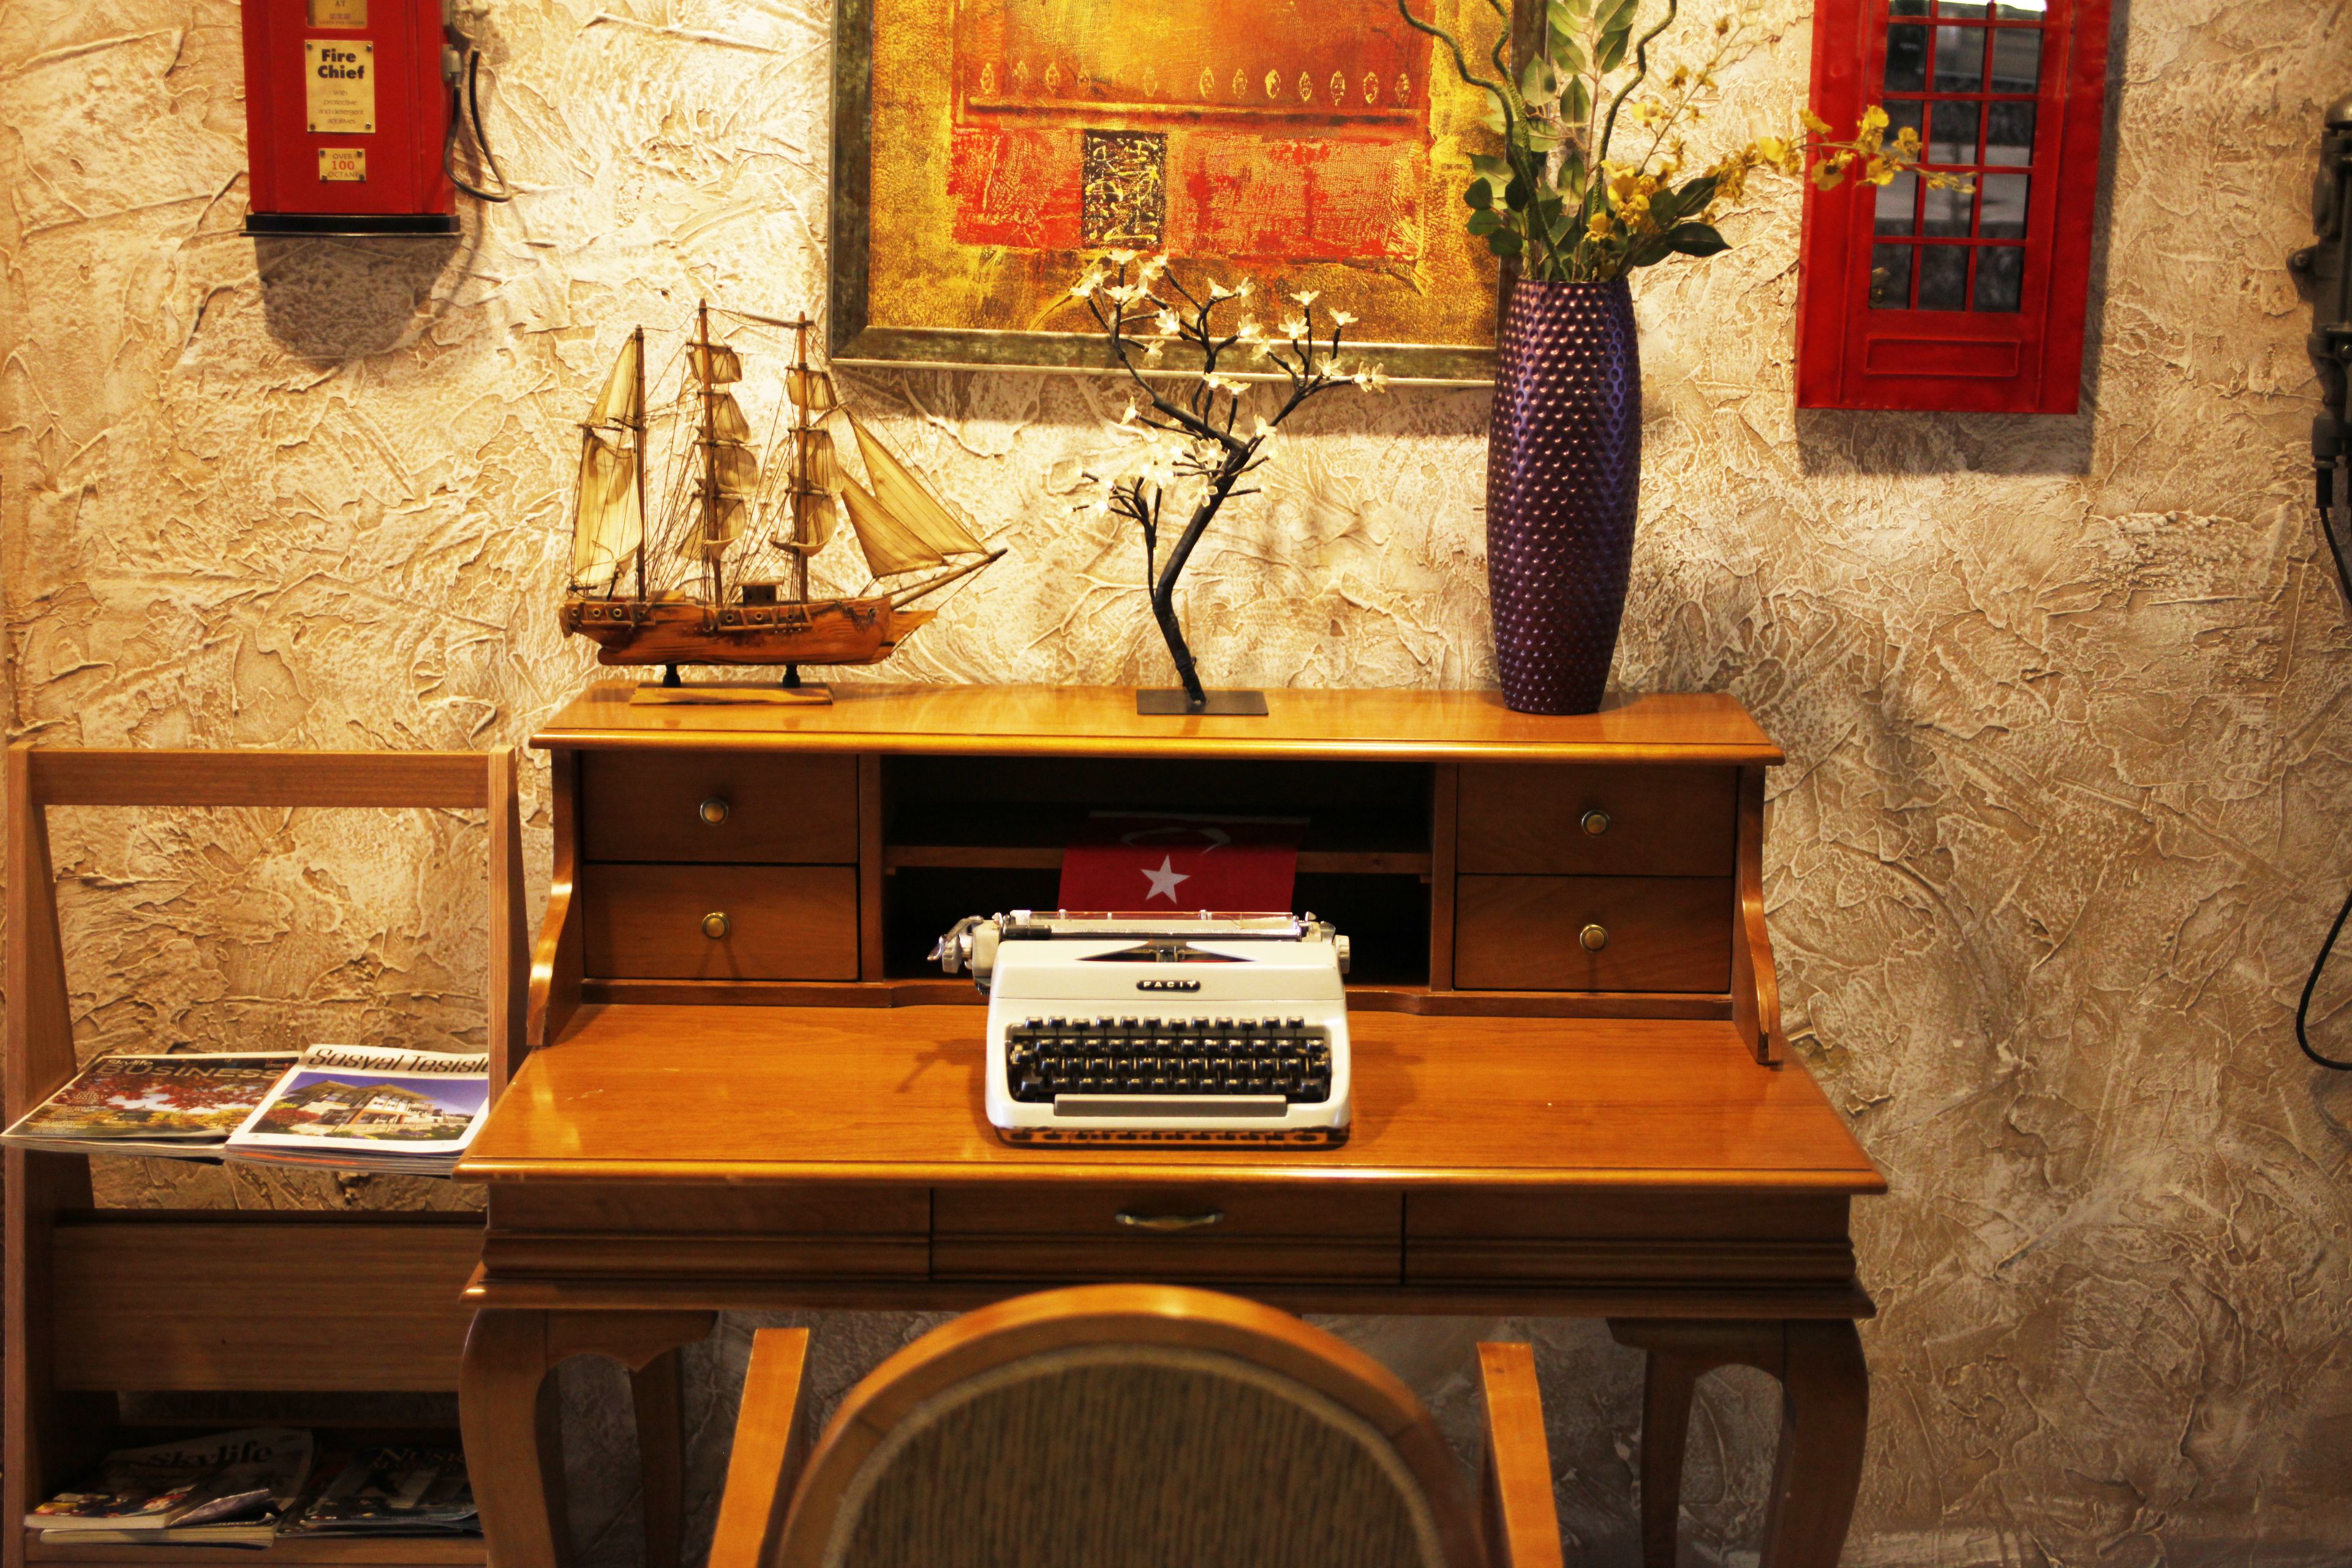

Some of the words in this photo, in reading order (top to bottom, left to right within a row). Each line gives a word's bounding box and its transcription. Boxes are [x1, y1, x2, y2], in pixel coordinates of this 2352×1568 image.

[321, 48, 356, 62] Fire
[317, 65, 365, 79] Chief
[332, 160, 355, 170] 100
[308, 1048, 404, 1070] Sosyal
[96, 1064, 283, 1079] BUSINESS
[149, 1439, 273, 1467] Skylife
